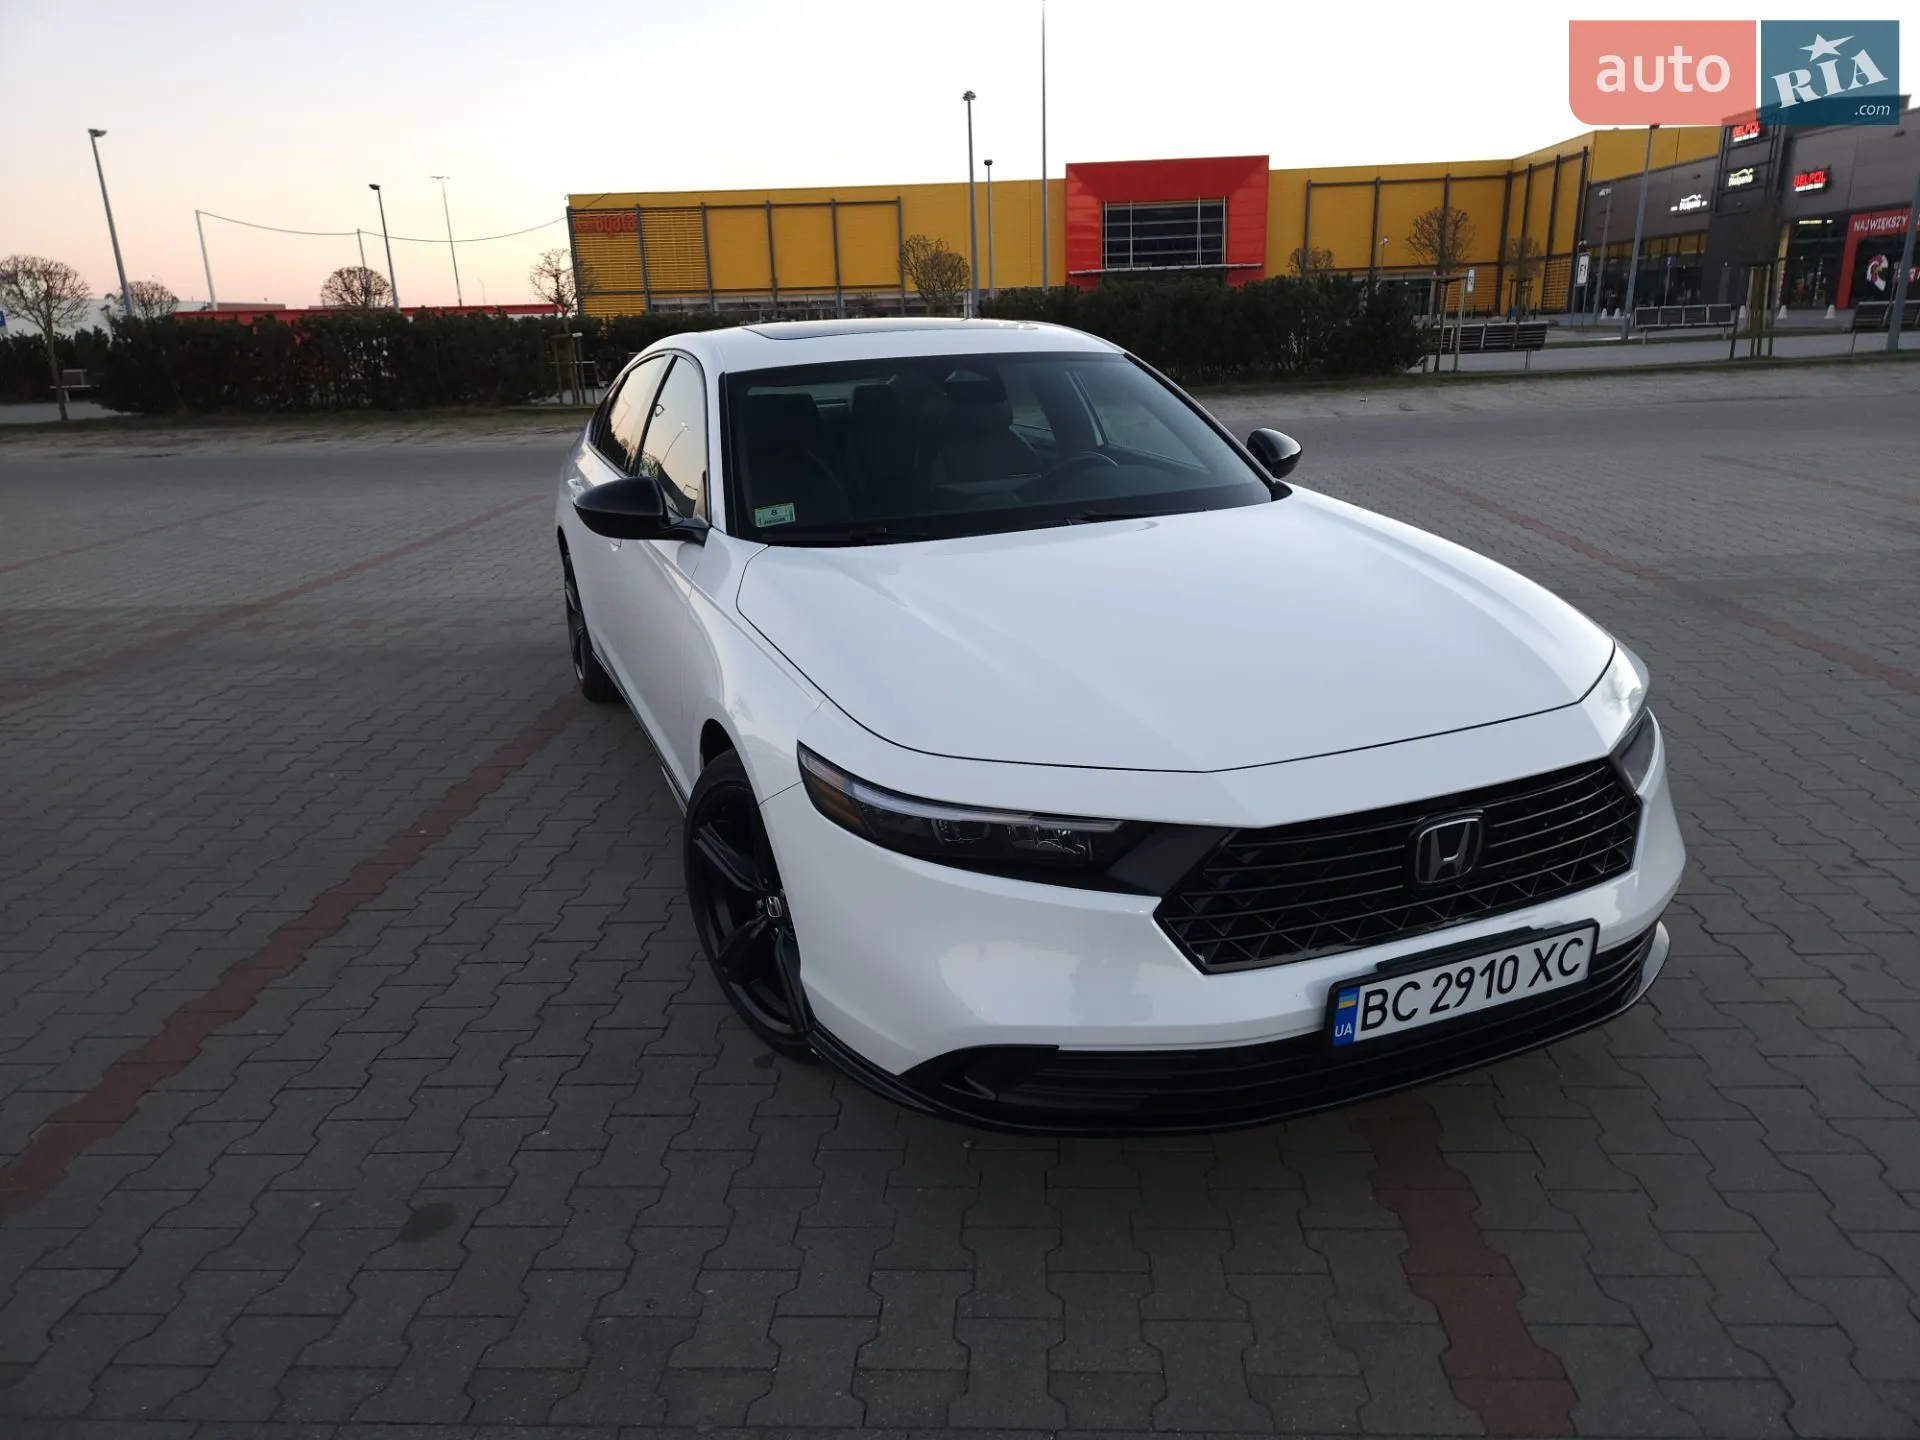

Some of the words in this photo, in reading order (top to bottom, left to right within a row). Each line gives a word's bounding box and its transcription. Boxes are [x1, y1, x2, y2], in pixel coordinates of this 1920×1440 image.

[1853, 214, 1909, 233] NAJWIĘKSZY
[1360, 980, 1421, 1032] BC
[1429, 954, 1520, 1015] 2910
[1528, 937, 1585, 989] XC
[1334, 1022, 1353, 1038] UA
